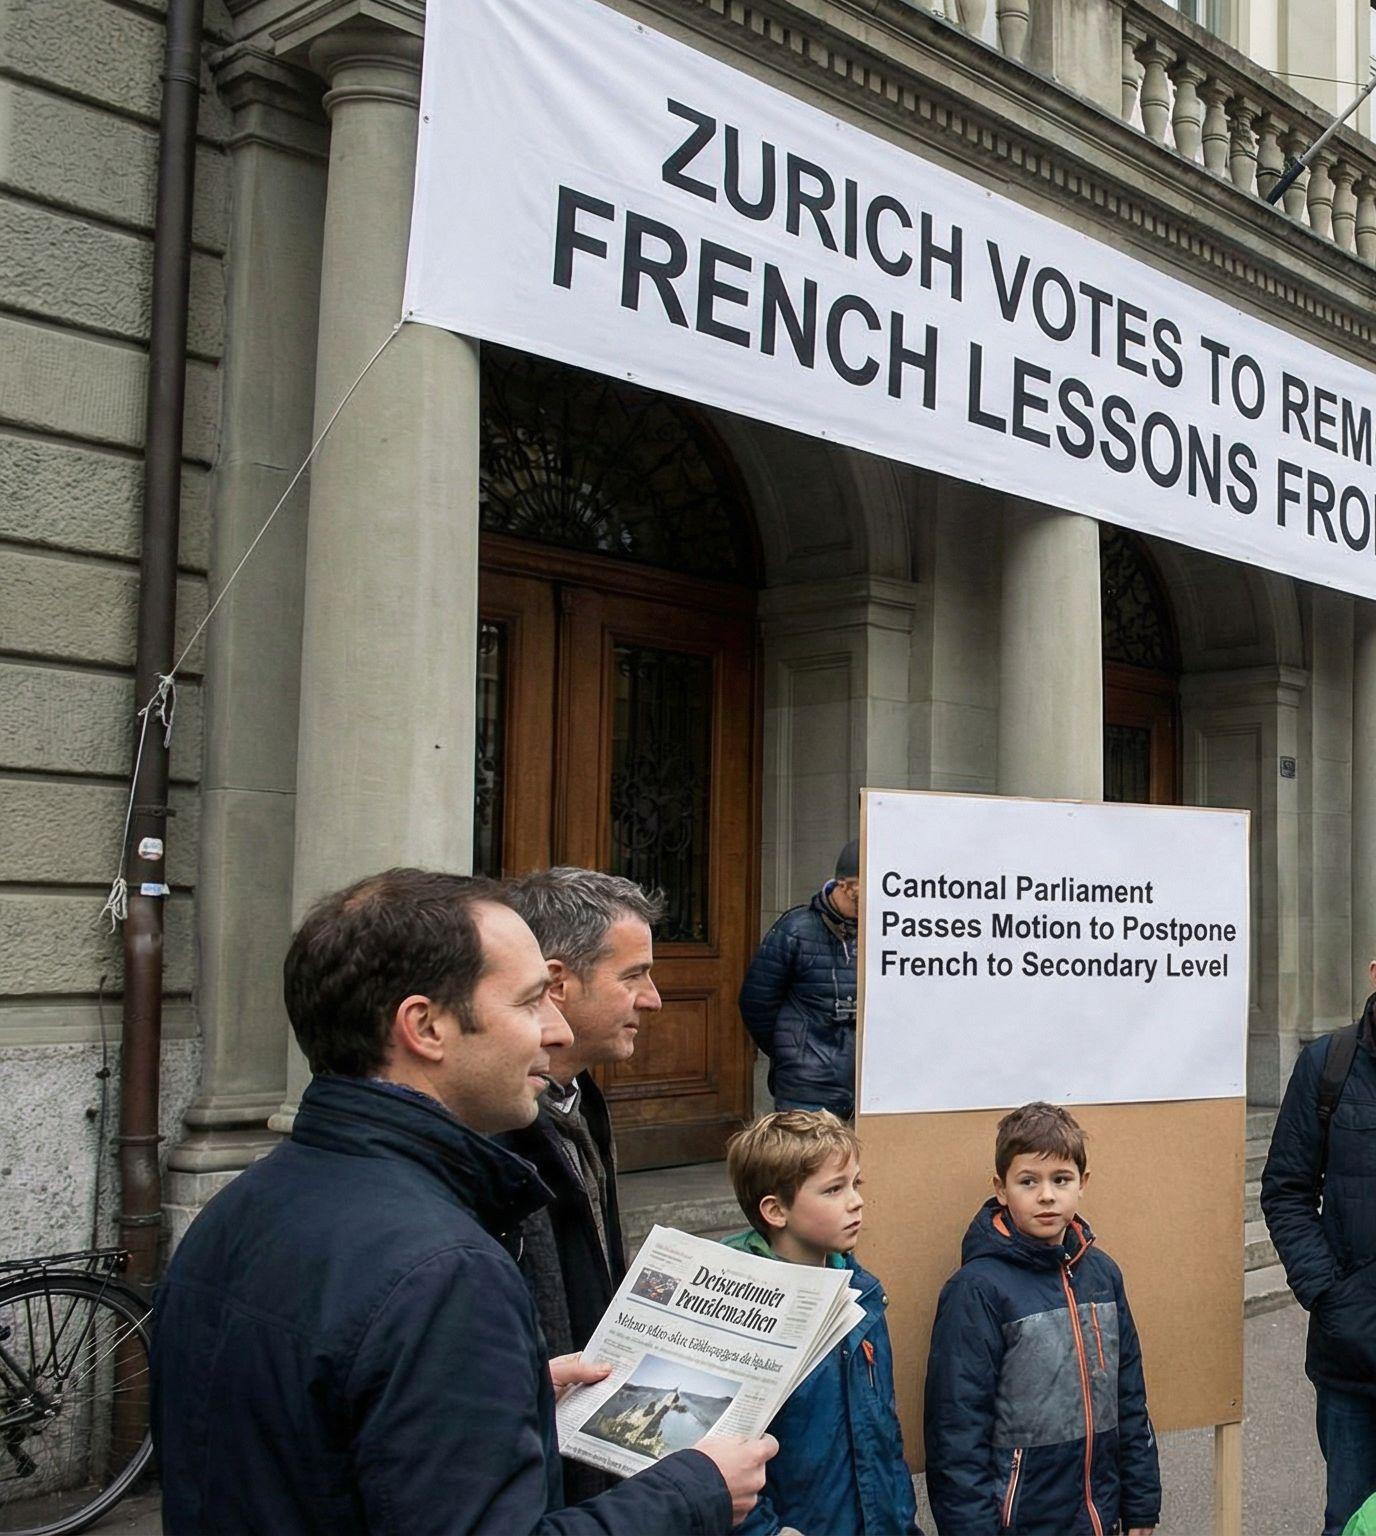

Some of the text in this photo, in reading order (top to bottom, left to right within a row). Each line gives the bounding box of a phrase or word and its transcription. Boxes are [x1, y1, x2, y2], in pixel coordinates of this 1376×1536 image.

[661, 97, 962, 303] ZURICH
[986, 240, 1183, 389] VOTES
[1200, 335, 1265, 420] TO
[552, 184, 938, 411] FRENCH
[967, 341, 1258, 515] LESSONS
[881, 871, 1154, 904] Cantonal Parliament
[882, 910, 1237, 948] Passes Motion to Postpone
[881, 950, 1229, 984] French to Secondary Level
